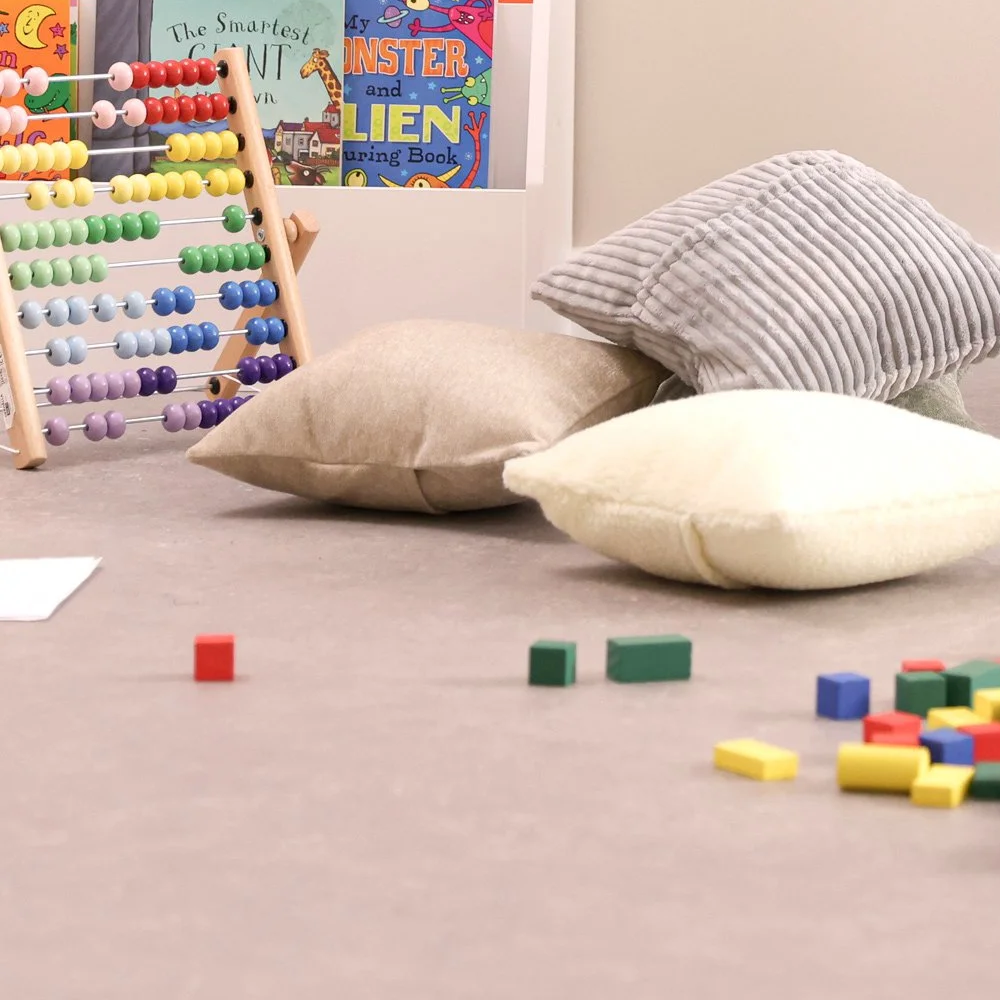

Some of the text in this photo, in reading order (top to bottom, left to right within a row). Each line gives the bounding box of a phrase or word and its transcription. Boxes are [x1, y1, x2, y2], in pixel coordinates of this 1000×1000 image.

[166, 11, 310, 45] The Smartest
[365, 80, 402, 98] and
[407, 146, 459, 165] Book
